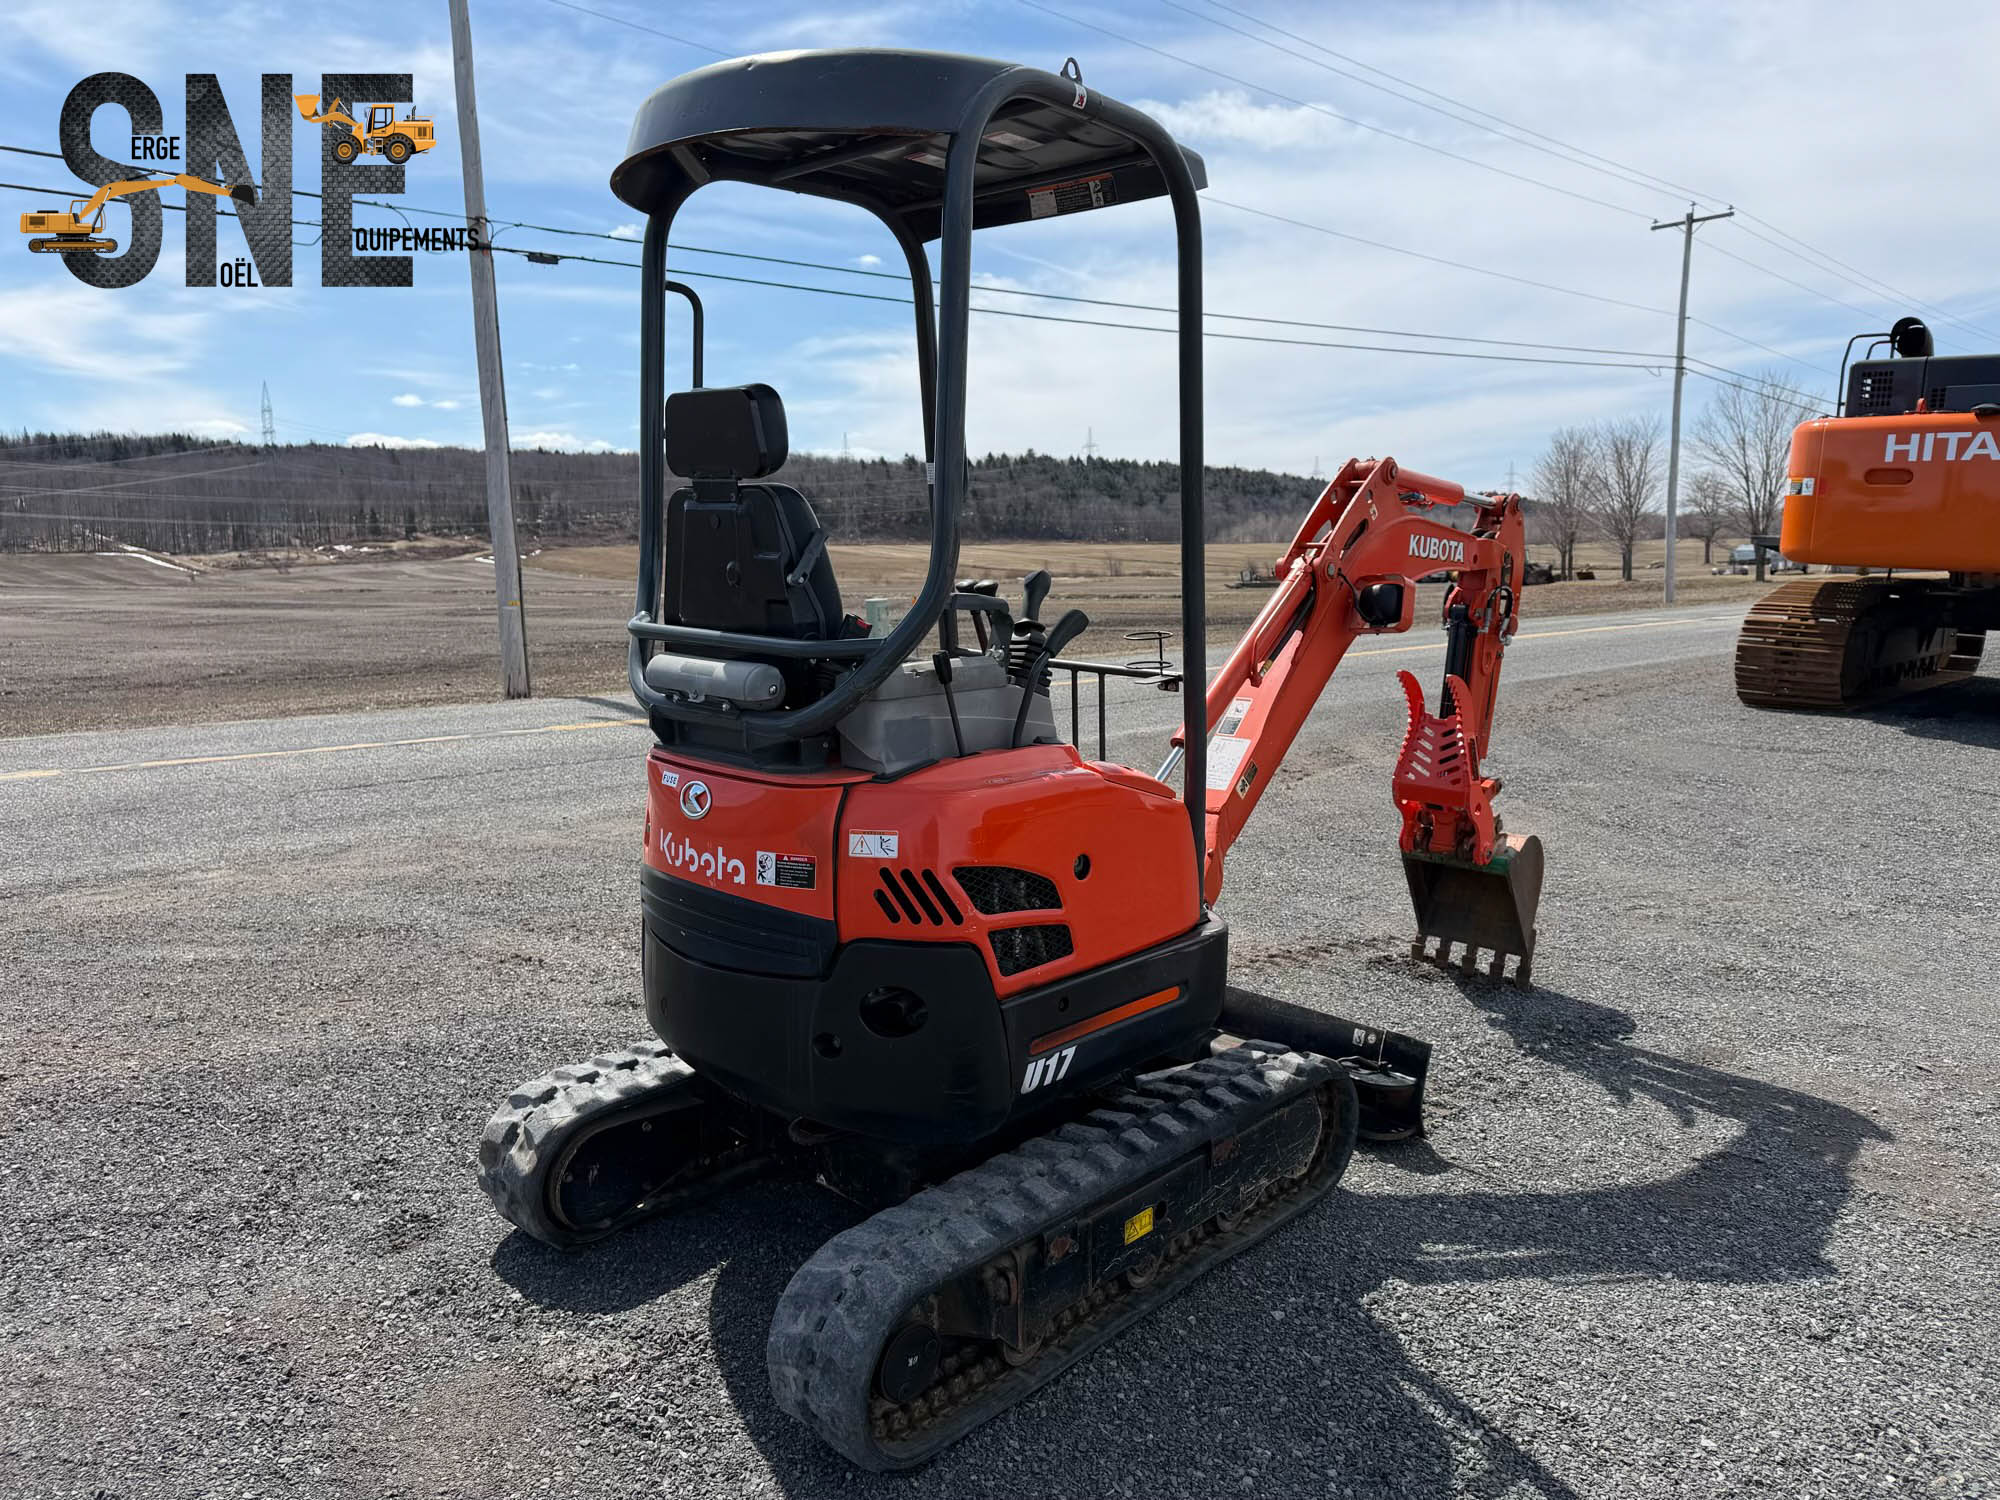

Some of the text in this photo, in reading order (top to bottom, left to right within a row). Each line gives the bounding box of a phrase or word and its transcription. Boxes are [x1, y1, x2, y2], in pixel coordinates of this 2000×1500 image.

[1884, 432, 2000, 462] HITA
[1408, 534, 1464, 563] KUBOTA
[663, 774, 678, 785] FUSE
[660, 827, 746, 885] Kubota
[1021, 1044, 1078, 1095] U17
